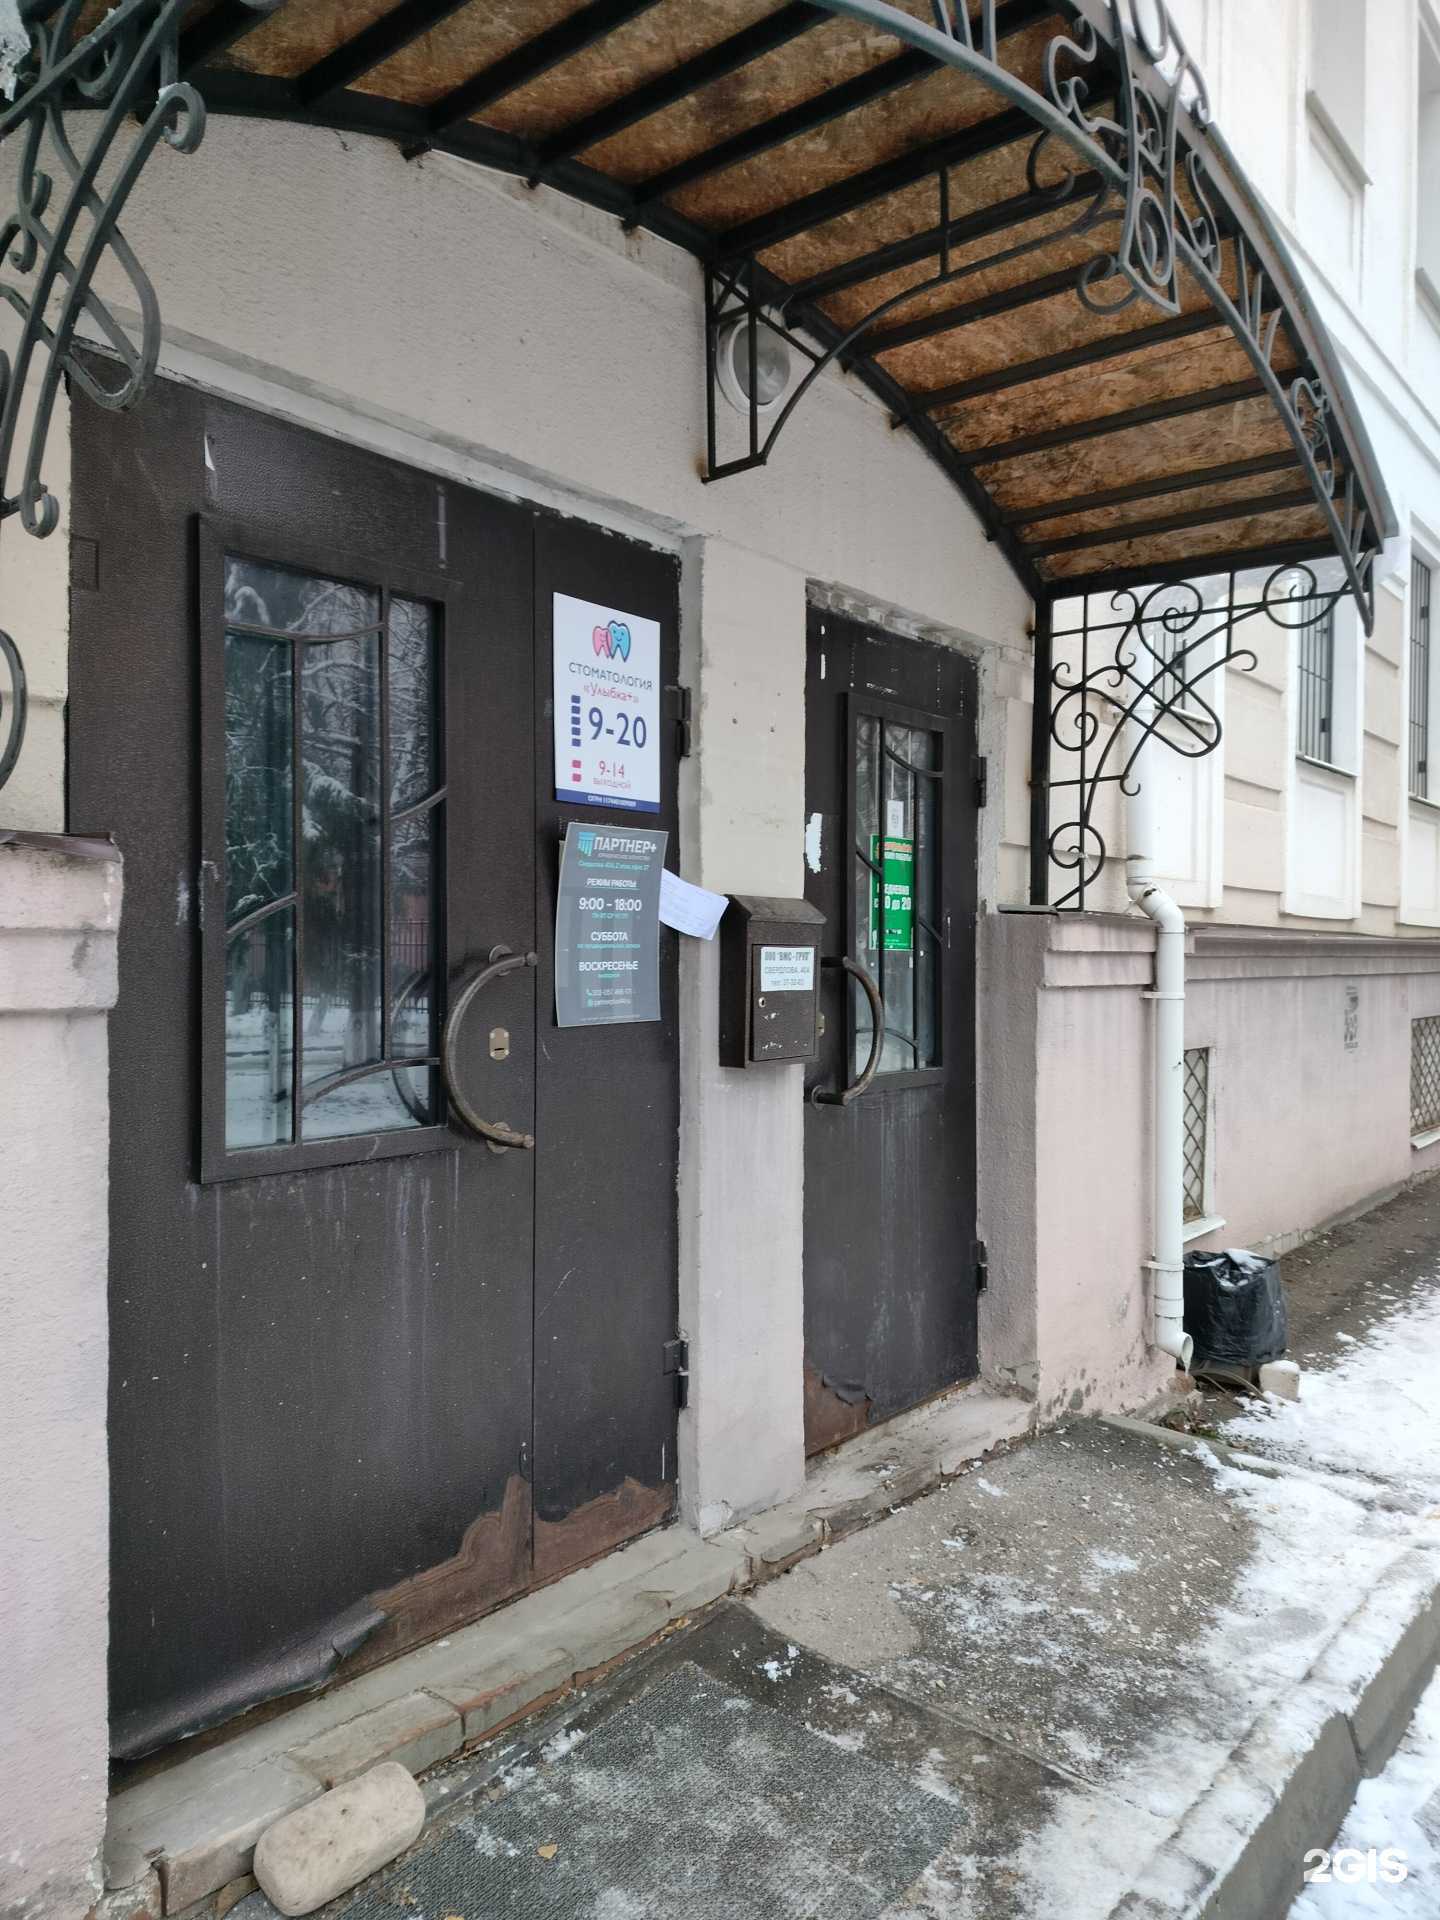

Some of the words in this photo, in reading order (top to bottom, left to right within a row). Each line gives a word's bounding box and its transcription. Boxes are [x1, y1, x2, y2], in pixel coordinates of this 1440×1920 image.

[568, 662, 652, 690] СТОМАТОЛОГИЯ
[589, 707, 647, 748] 9-20
[599, 760, 625, 778] 9-14
[593, 836, 657, 854] ПАРТНЕР+
[586, 878, 610, 887] РЕЖИМ
[611, 880, 637, 888] РАБОТЫ
[579, 897, 604, 910] 9:00
[614, 898, 642, 911] 18:00
[591, 931, 629, 941] СУББОТА
[578, 961, 639, 971] ВОСКРЕСЕНЬЕ
